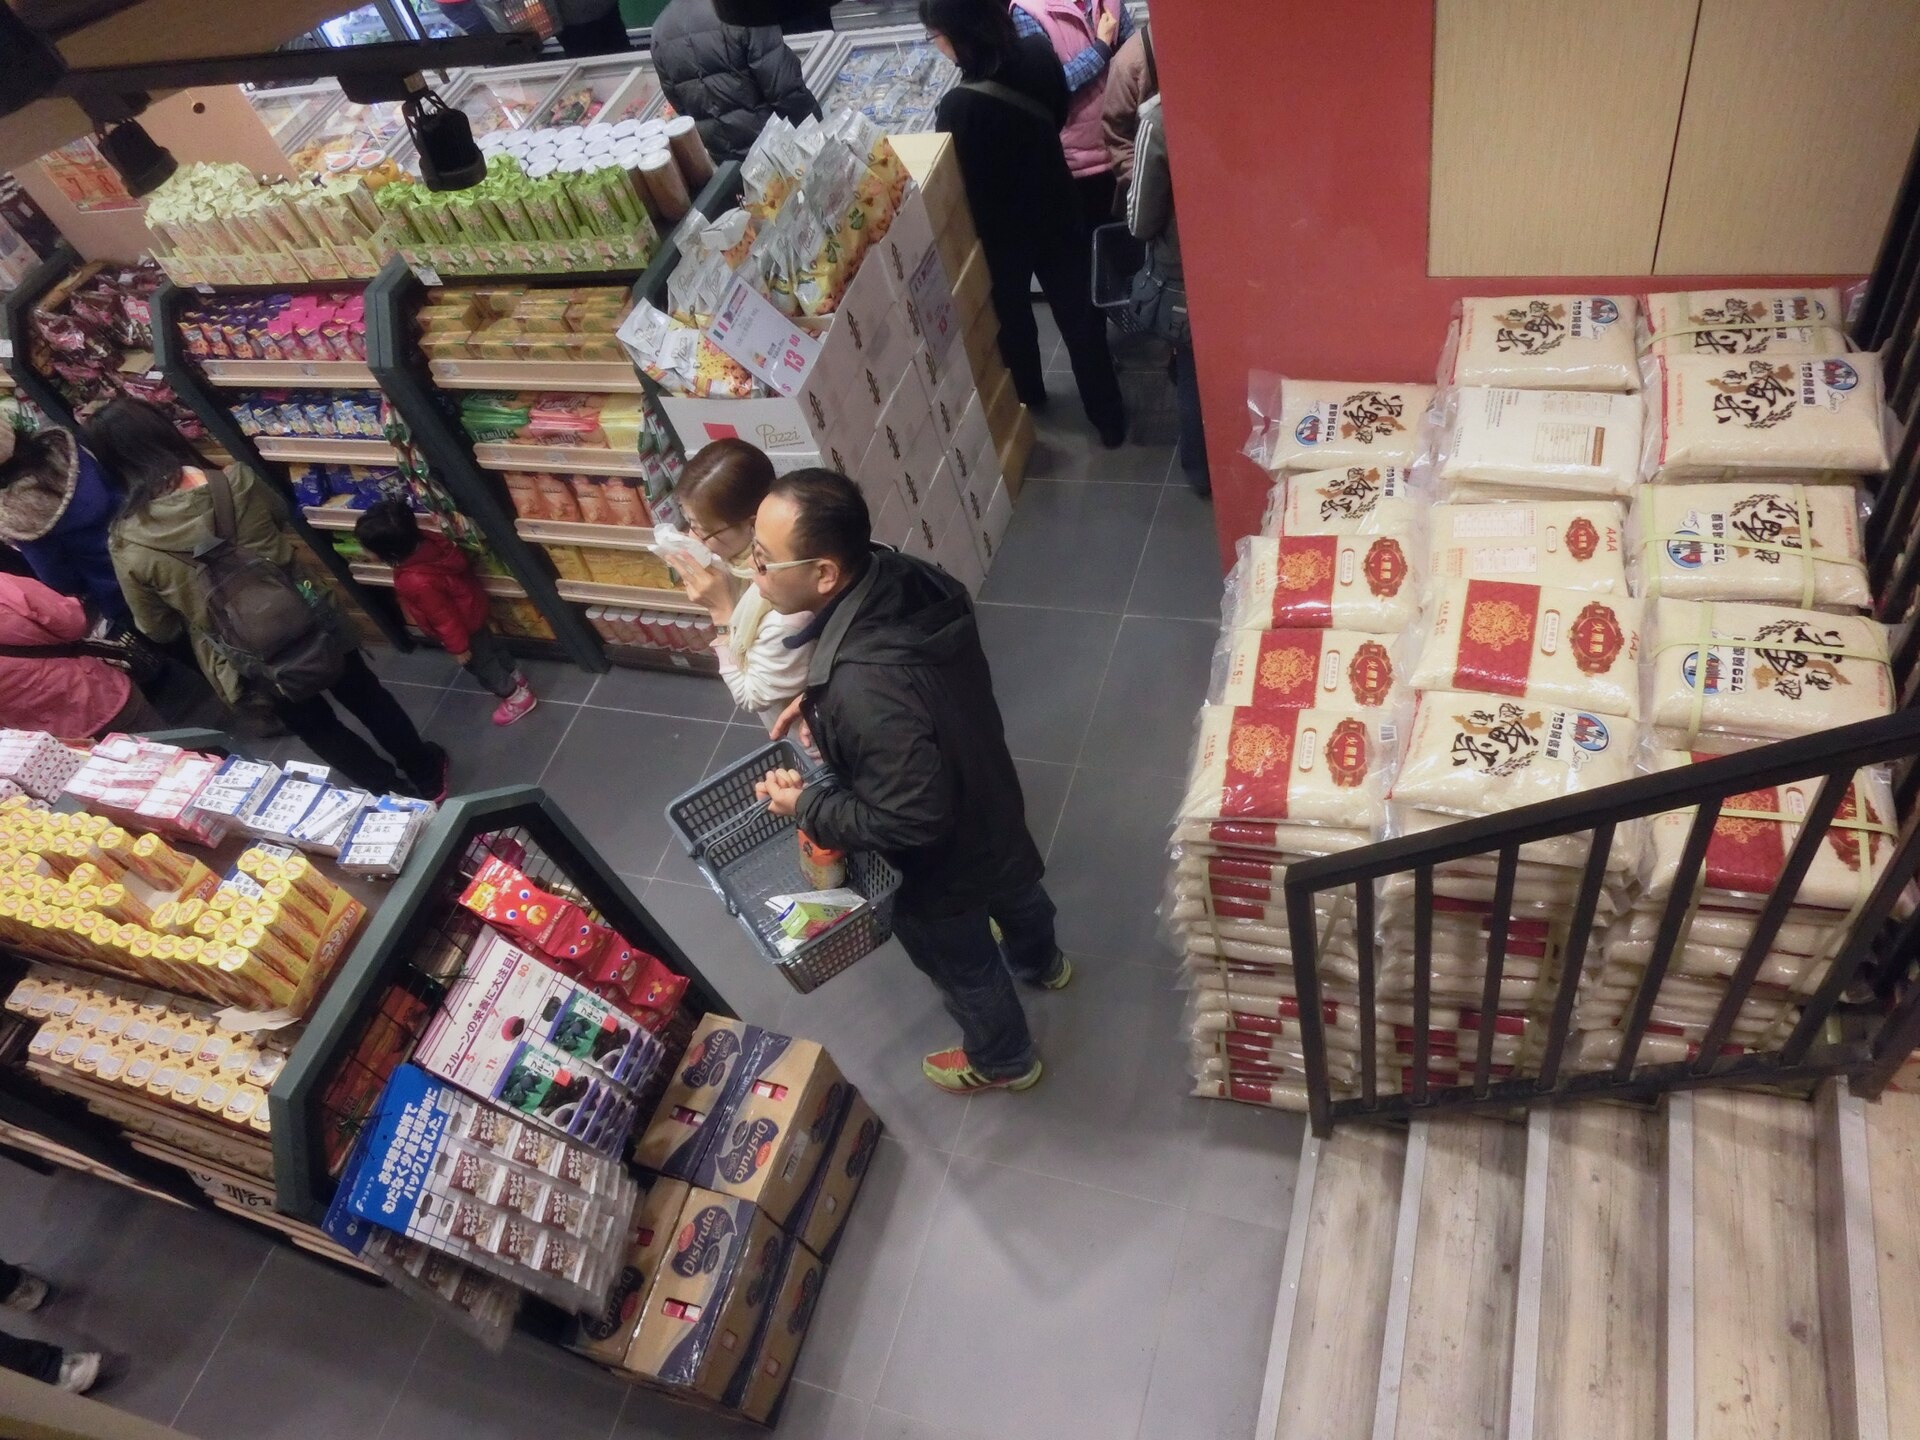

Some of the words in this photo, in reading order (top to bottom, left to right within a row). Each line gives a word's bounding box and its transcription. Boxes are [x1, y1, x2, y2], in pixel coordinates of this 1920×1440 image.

[781, 348, 807, 373] 13
[756, 424, 800, 449] Pozzi
[1606, 527, 1618, 552] AAA
[1628, 631, 1639, 660] AAA
[1546, 712, 1565, 758] 759阿信屋
[516, 962, 531, 978] 80
[690, 1030, 727, 1087] Disfruta
[732, 1120, 769, 1183] Disfruta
[680, 1208, 718, 1275] Disfruta
